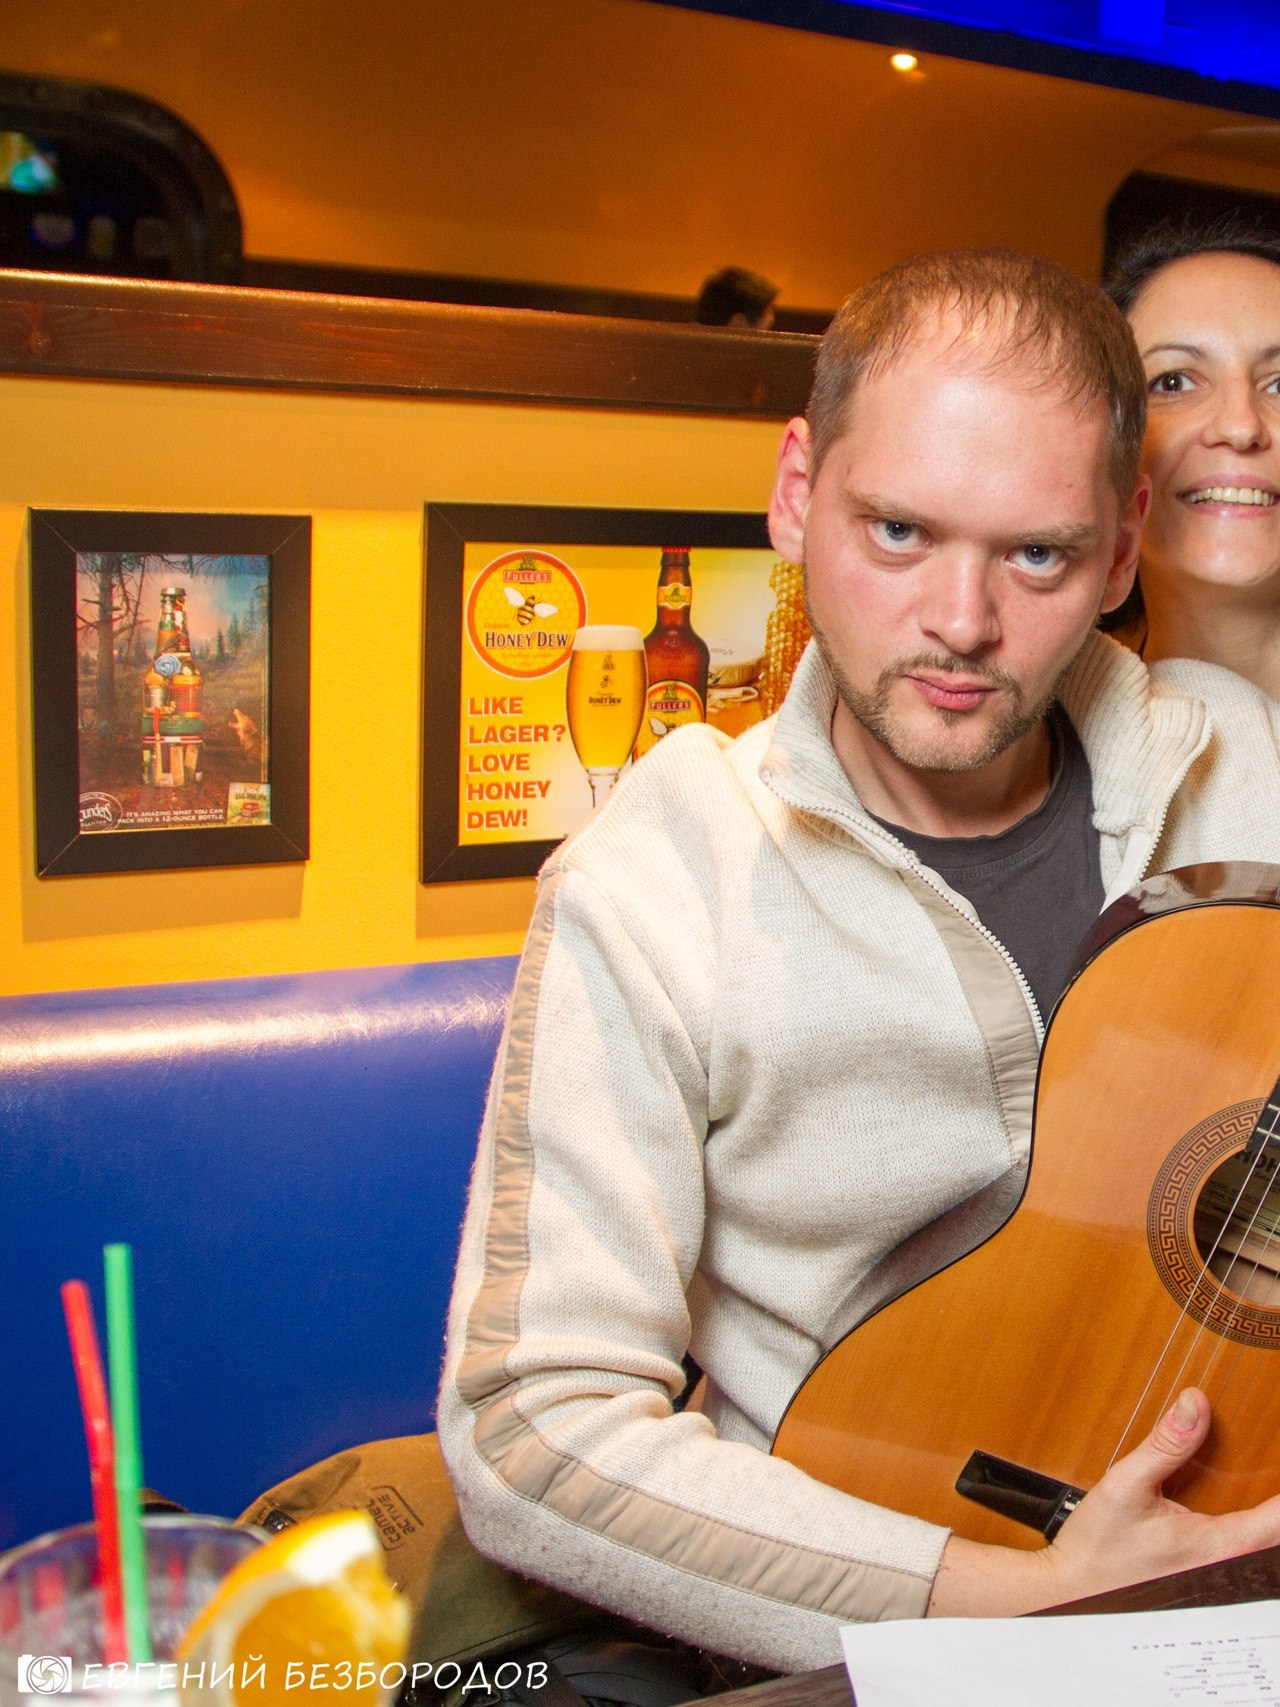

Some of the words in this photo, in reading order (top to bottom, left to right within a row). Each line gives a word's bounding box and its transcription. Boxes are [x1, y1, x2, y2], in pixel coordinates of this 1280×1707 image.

[467, 696, 523, 717] LIKE
[467, 724, 566, 746] LAGER?
[466, 752, 530, 775] LOVE
[466, 780, 551, 803] HONEY
[466, 809, 528, 831] DEW!
